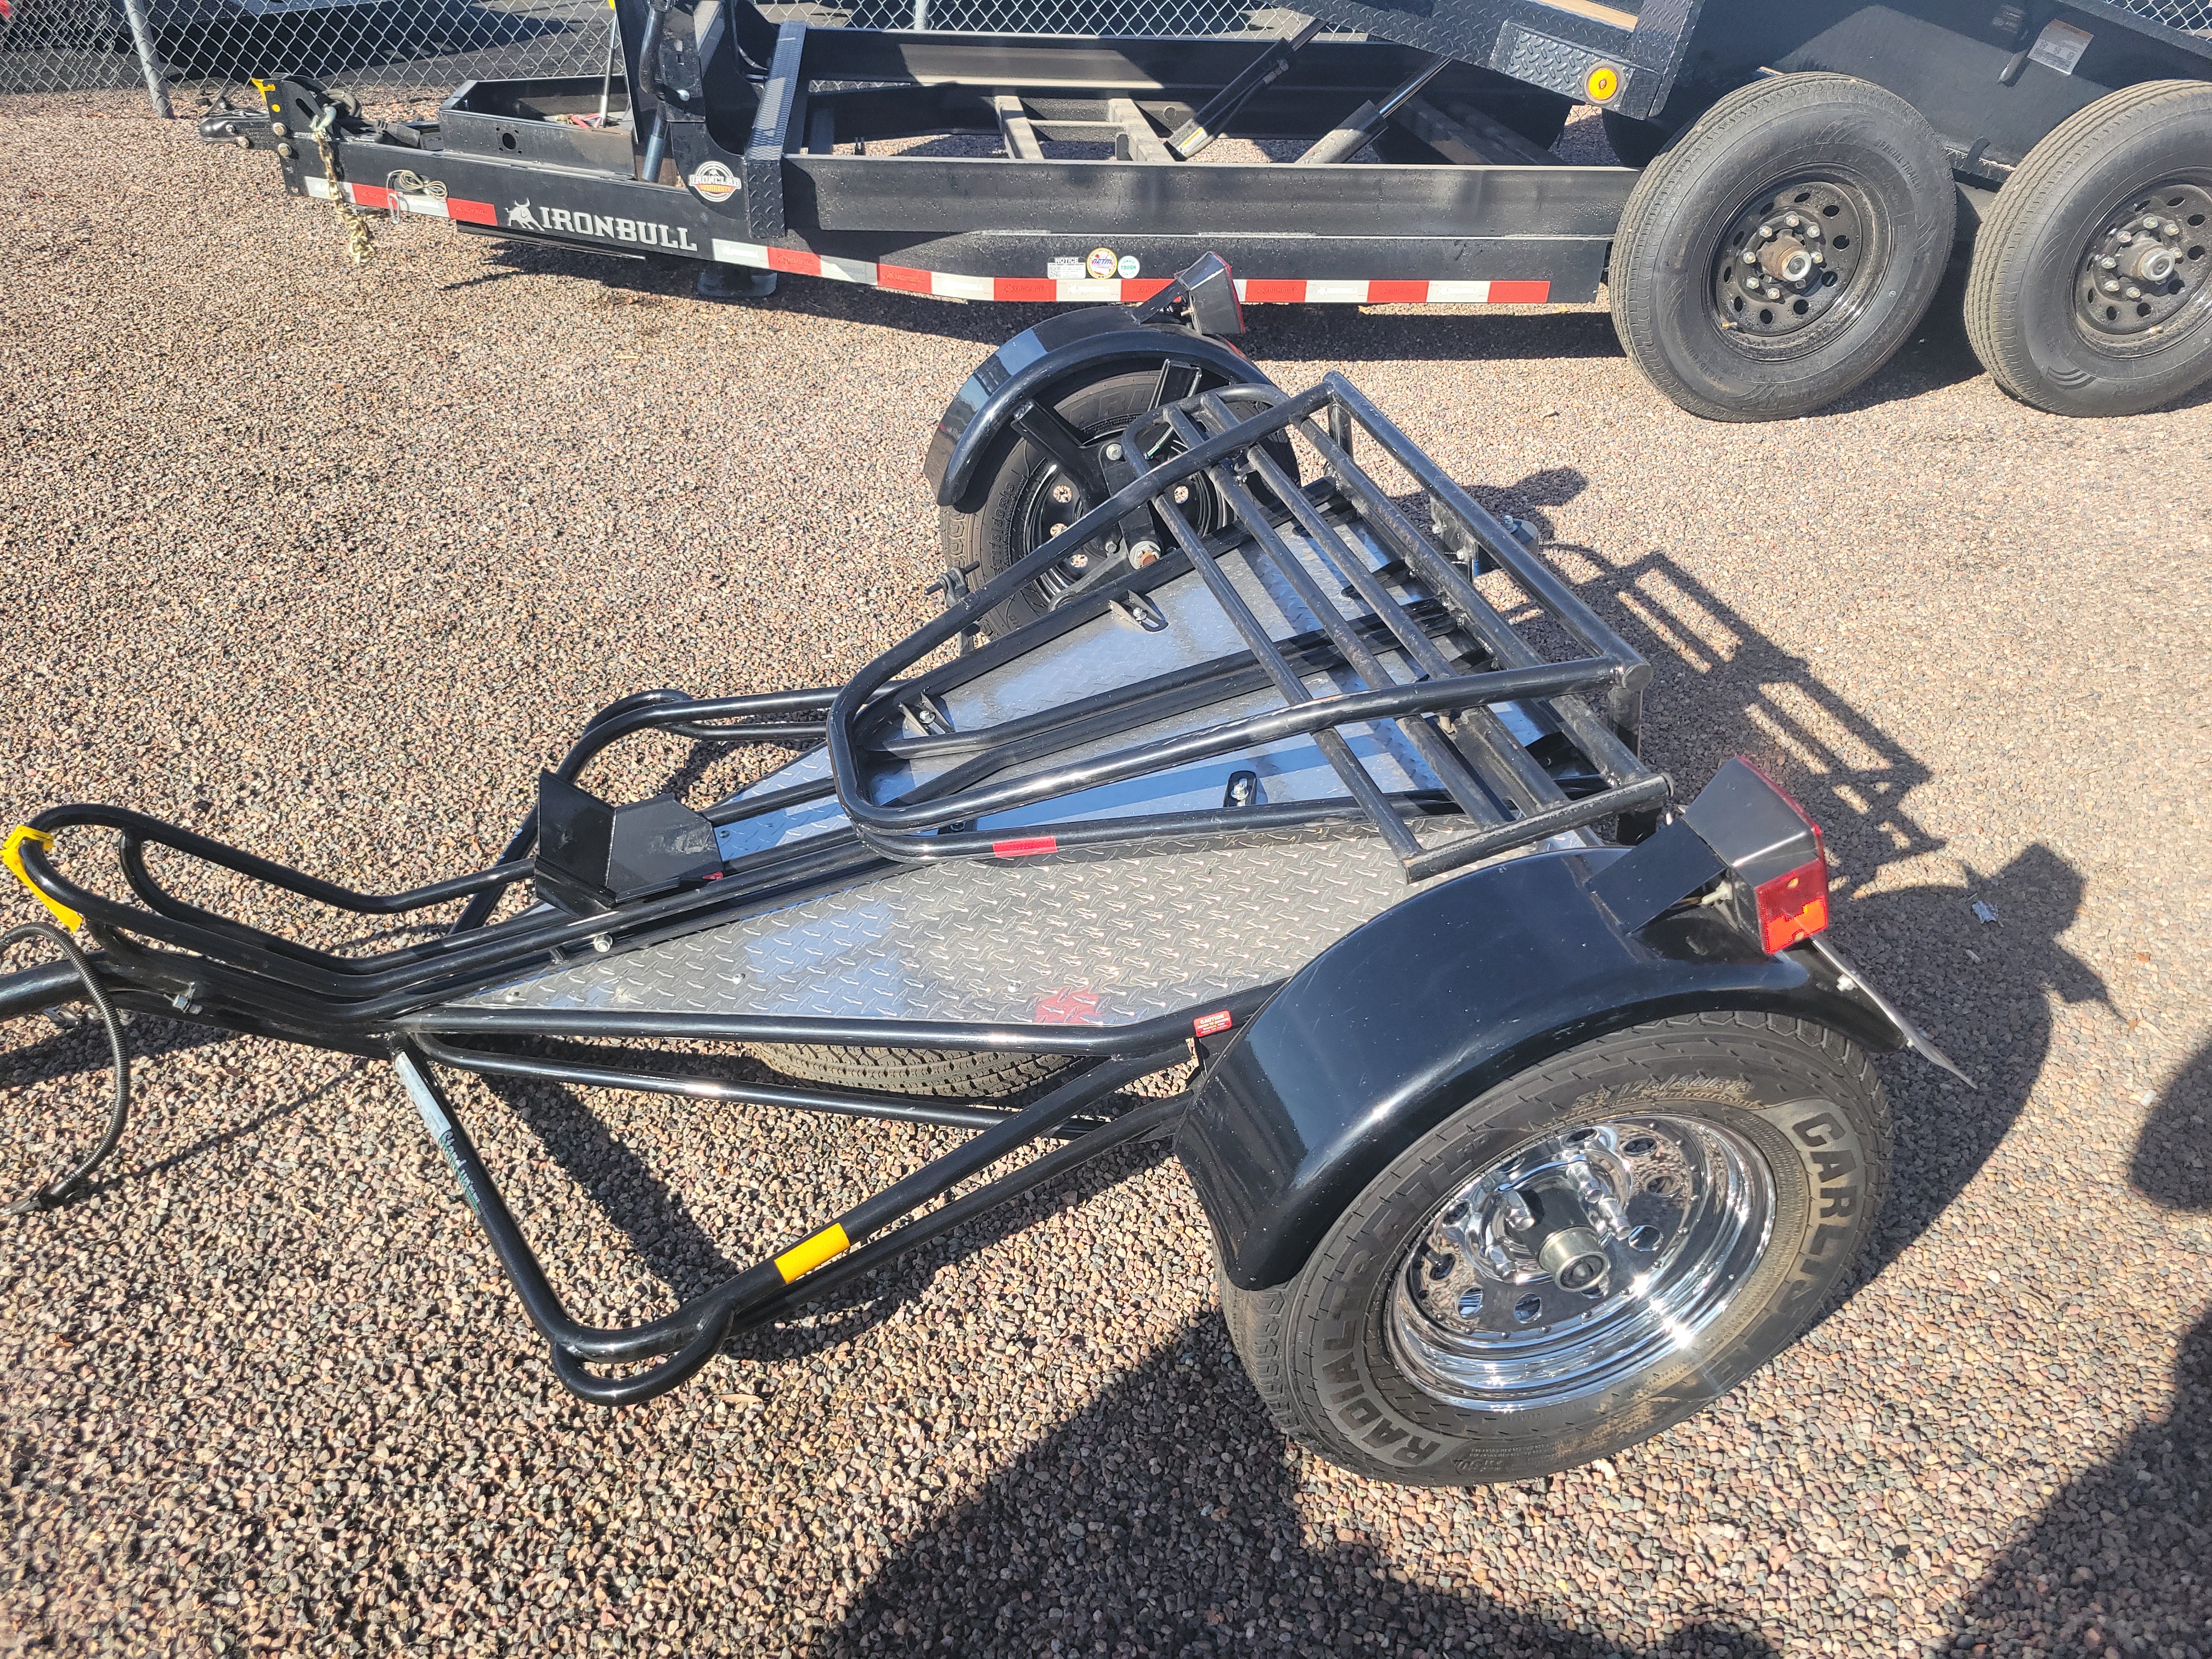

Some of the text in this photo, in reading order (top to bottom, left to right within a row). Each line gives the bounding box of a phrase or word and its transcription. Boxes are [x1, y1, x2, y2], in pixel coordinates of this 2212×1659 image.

[691, 176, 739, 187] IRONCLAD
[700, 184, 731, 193] WARRANTY
[539, 206, 698, 252] IRONBULL
[1200, 1013, 1224, 1024] CAUTION
[471, 1192, 481, 1204] BIKE
[1319, 1159, 1473, 1319] TRAIL
[1322, 1318, 1441, 1466] RADIAL
